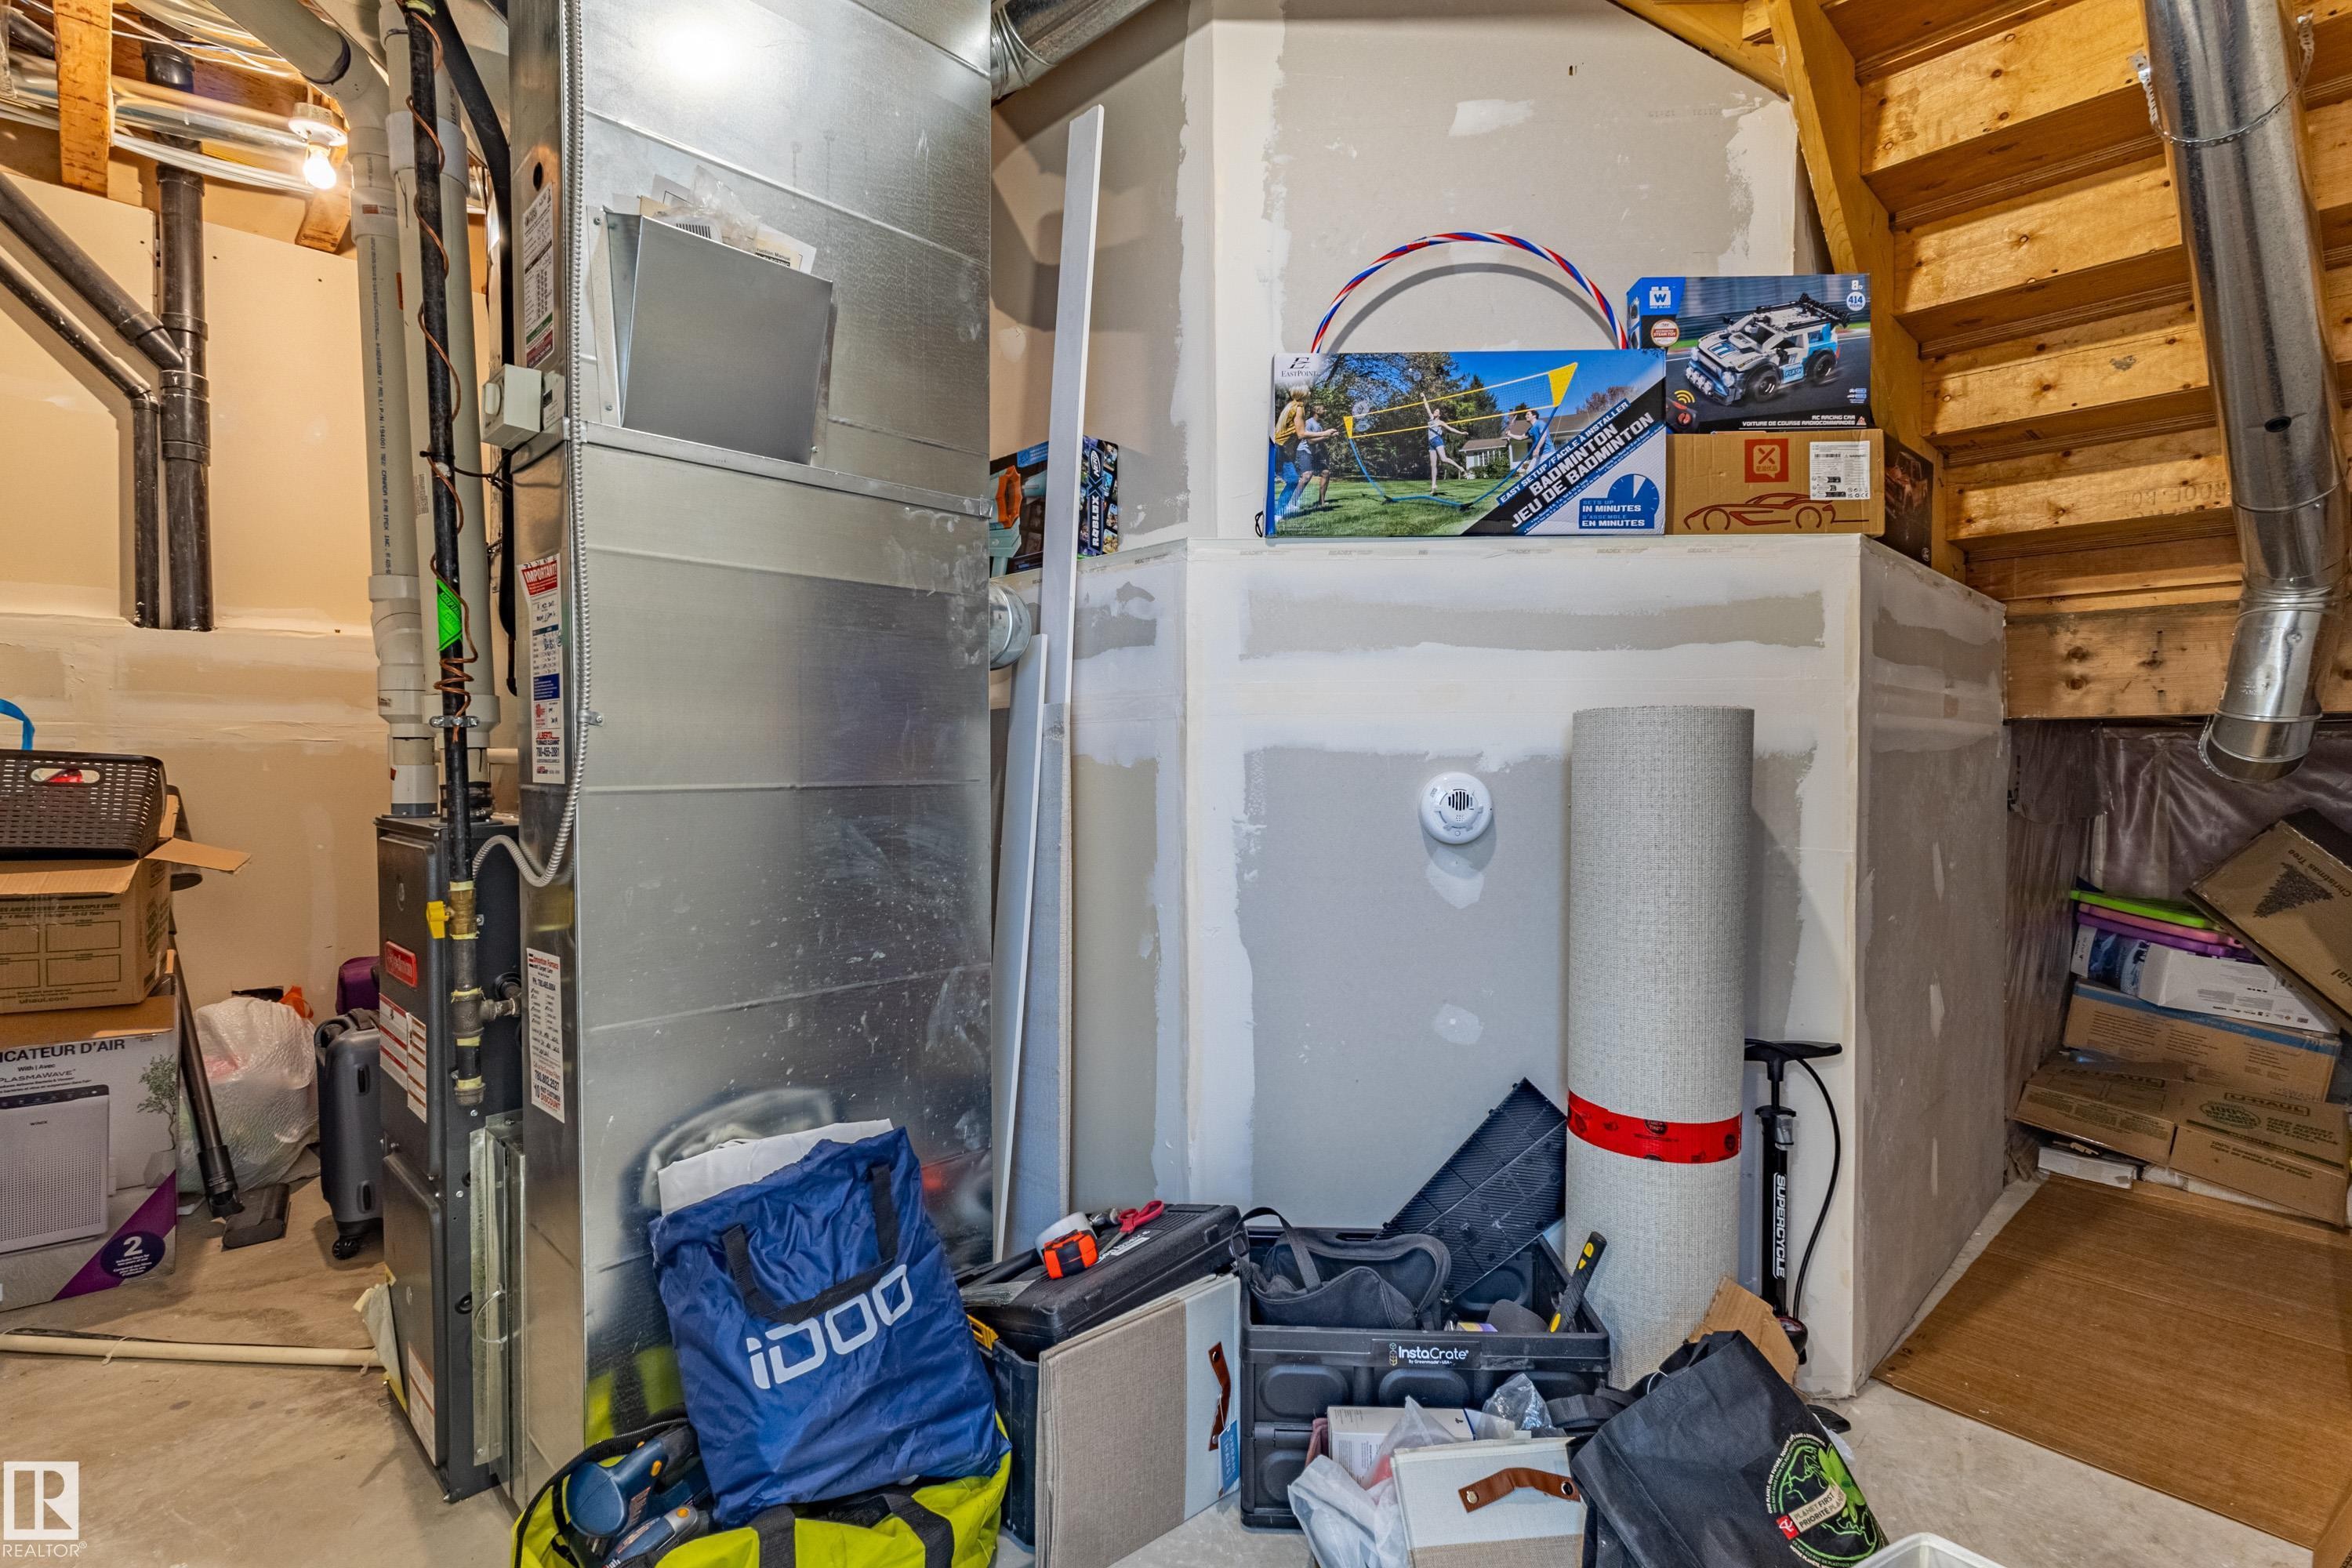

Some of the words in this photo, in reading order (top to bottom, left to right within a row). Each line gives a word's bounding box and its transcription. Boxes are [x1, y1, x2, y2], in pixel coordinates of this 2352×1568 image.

[775, 252, 791, 261] Manual
[1848, 296, 1864, 304] 414
[1090, 450, 1101, 477] NERF
[1500, 485, 1521, 503] EASY
[1585, 401, 1631, 437] INSTALLER
[1529, 423, 1619, 496] BADMINTON
[1512, 497, 1544, 528] JEU
[1541, 481, 1567, 504] DE
[1565, 412, 1655, 485] BADMINTON
[1091, 495, 1100, 547] ROBLOX
[1595, 504, 1642, 513] MINUTES
[2287, 848, 2307, 866] Tree
[2308, 863, 2352, 897] Christmas
[80, 1039, 126, 1054] D'AIR
[1776, 1174, 1787, 1279] SUPERCYCLE
[123, 1236, 143, 1258] 2
[1793, 1502, 1820, 1520] PLANET
[1818, 1493, 1835, 1508] FIRST
[1798, 1507, 1831, 1529] PRIORITÉ
